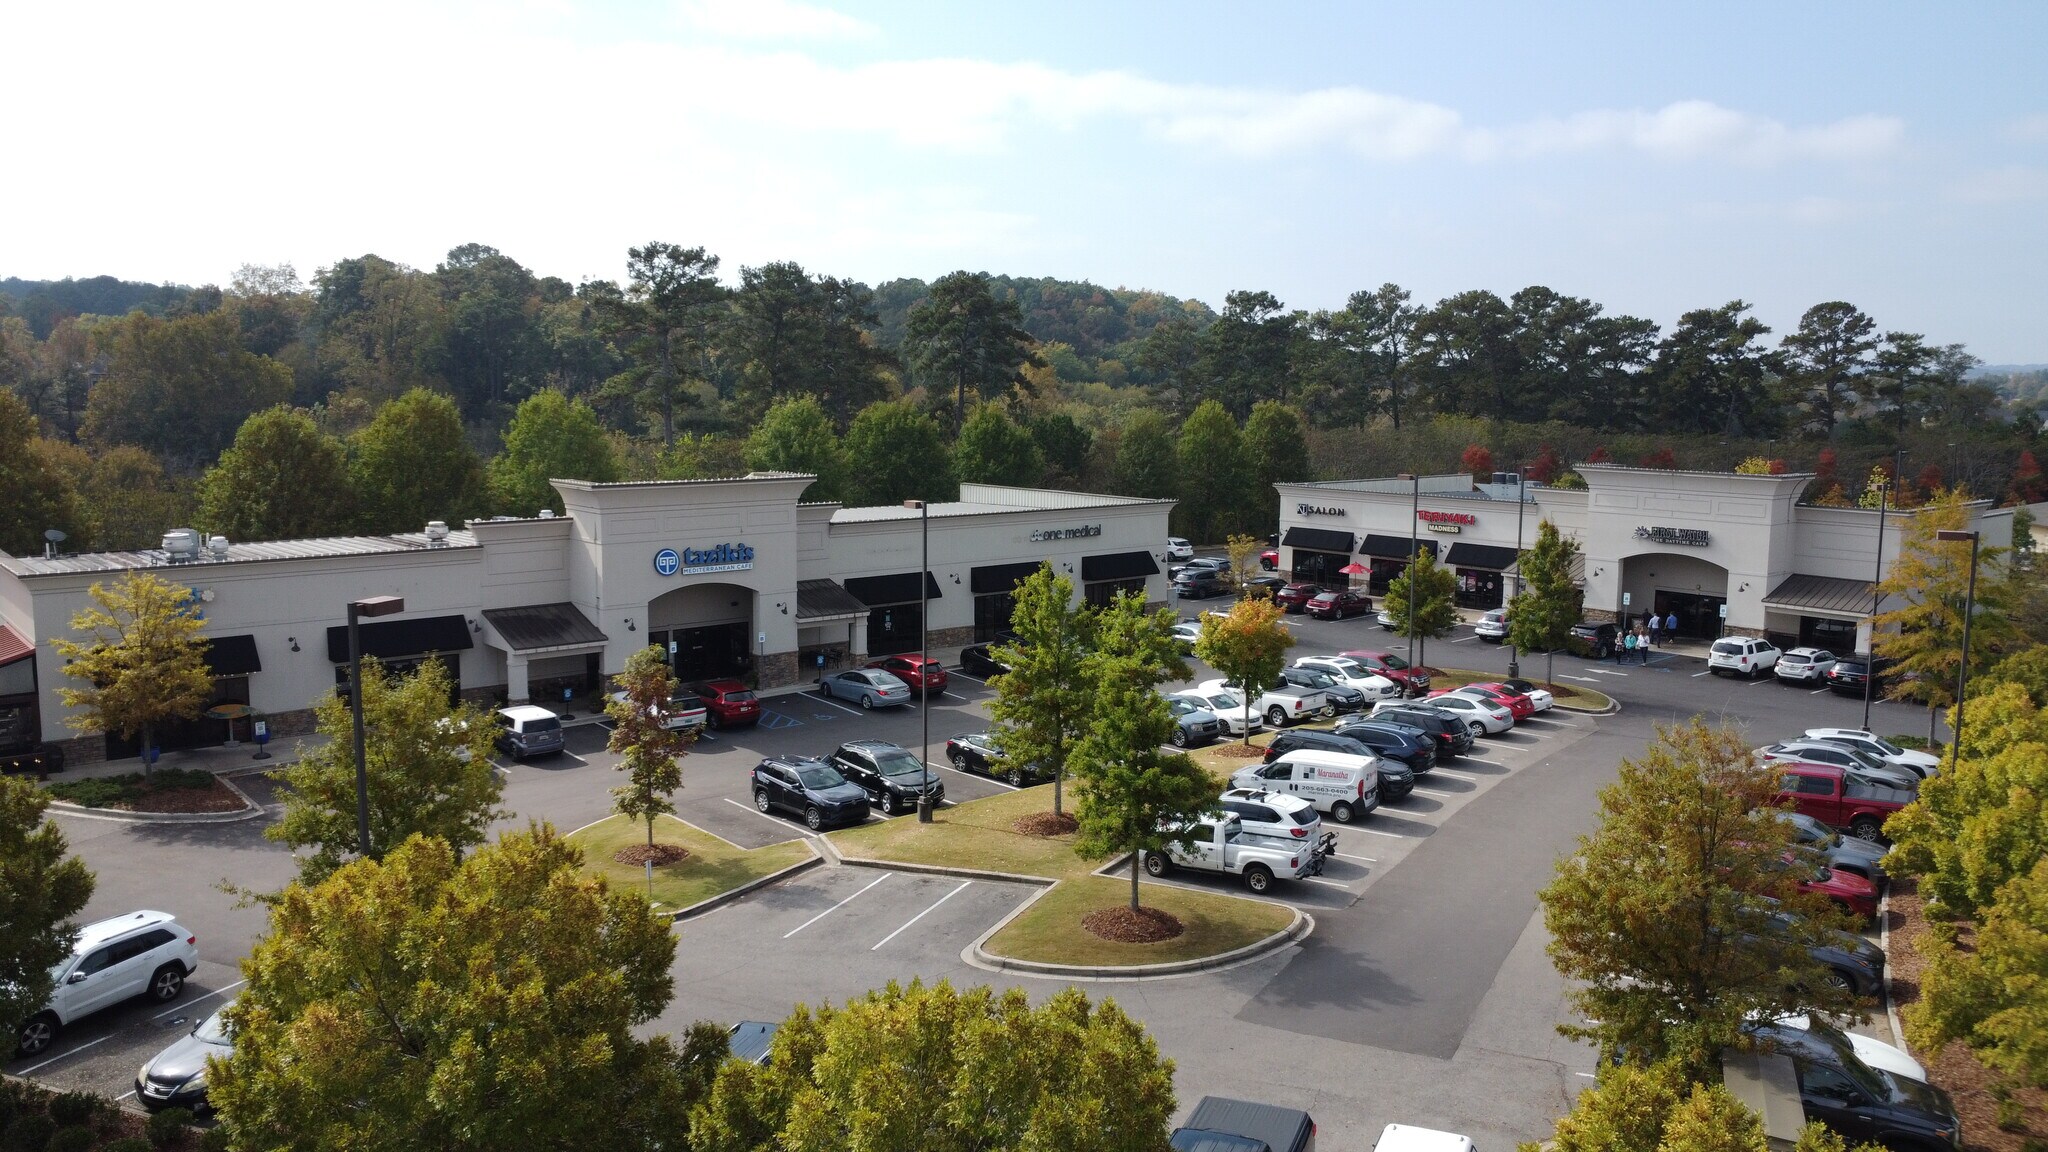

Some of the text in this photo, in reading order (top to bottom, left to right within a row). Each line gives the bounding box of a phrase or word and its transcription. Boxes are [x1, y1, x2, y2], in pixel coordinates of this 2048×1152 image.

[1308, 506, 1345, 517] SALON
[1417, 510, 1476, 526] TERIYAKI
[1043, 524, 1101, 540] one medical
[1429, 524, 1459, 533] MADNESS
[1652, 526, 1709, 542] FIRST WATCH
[683, 565, 735, 574] MEDITERRANEAN
